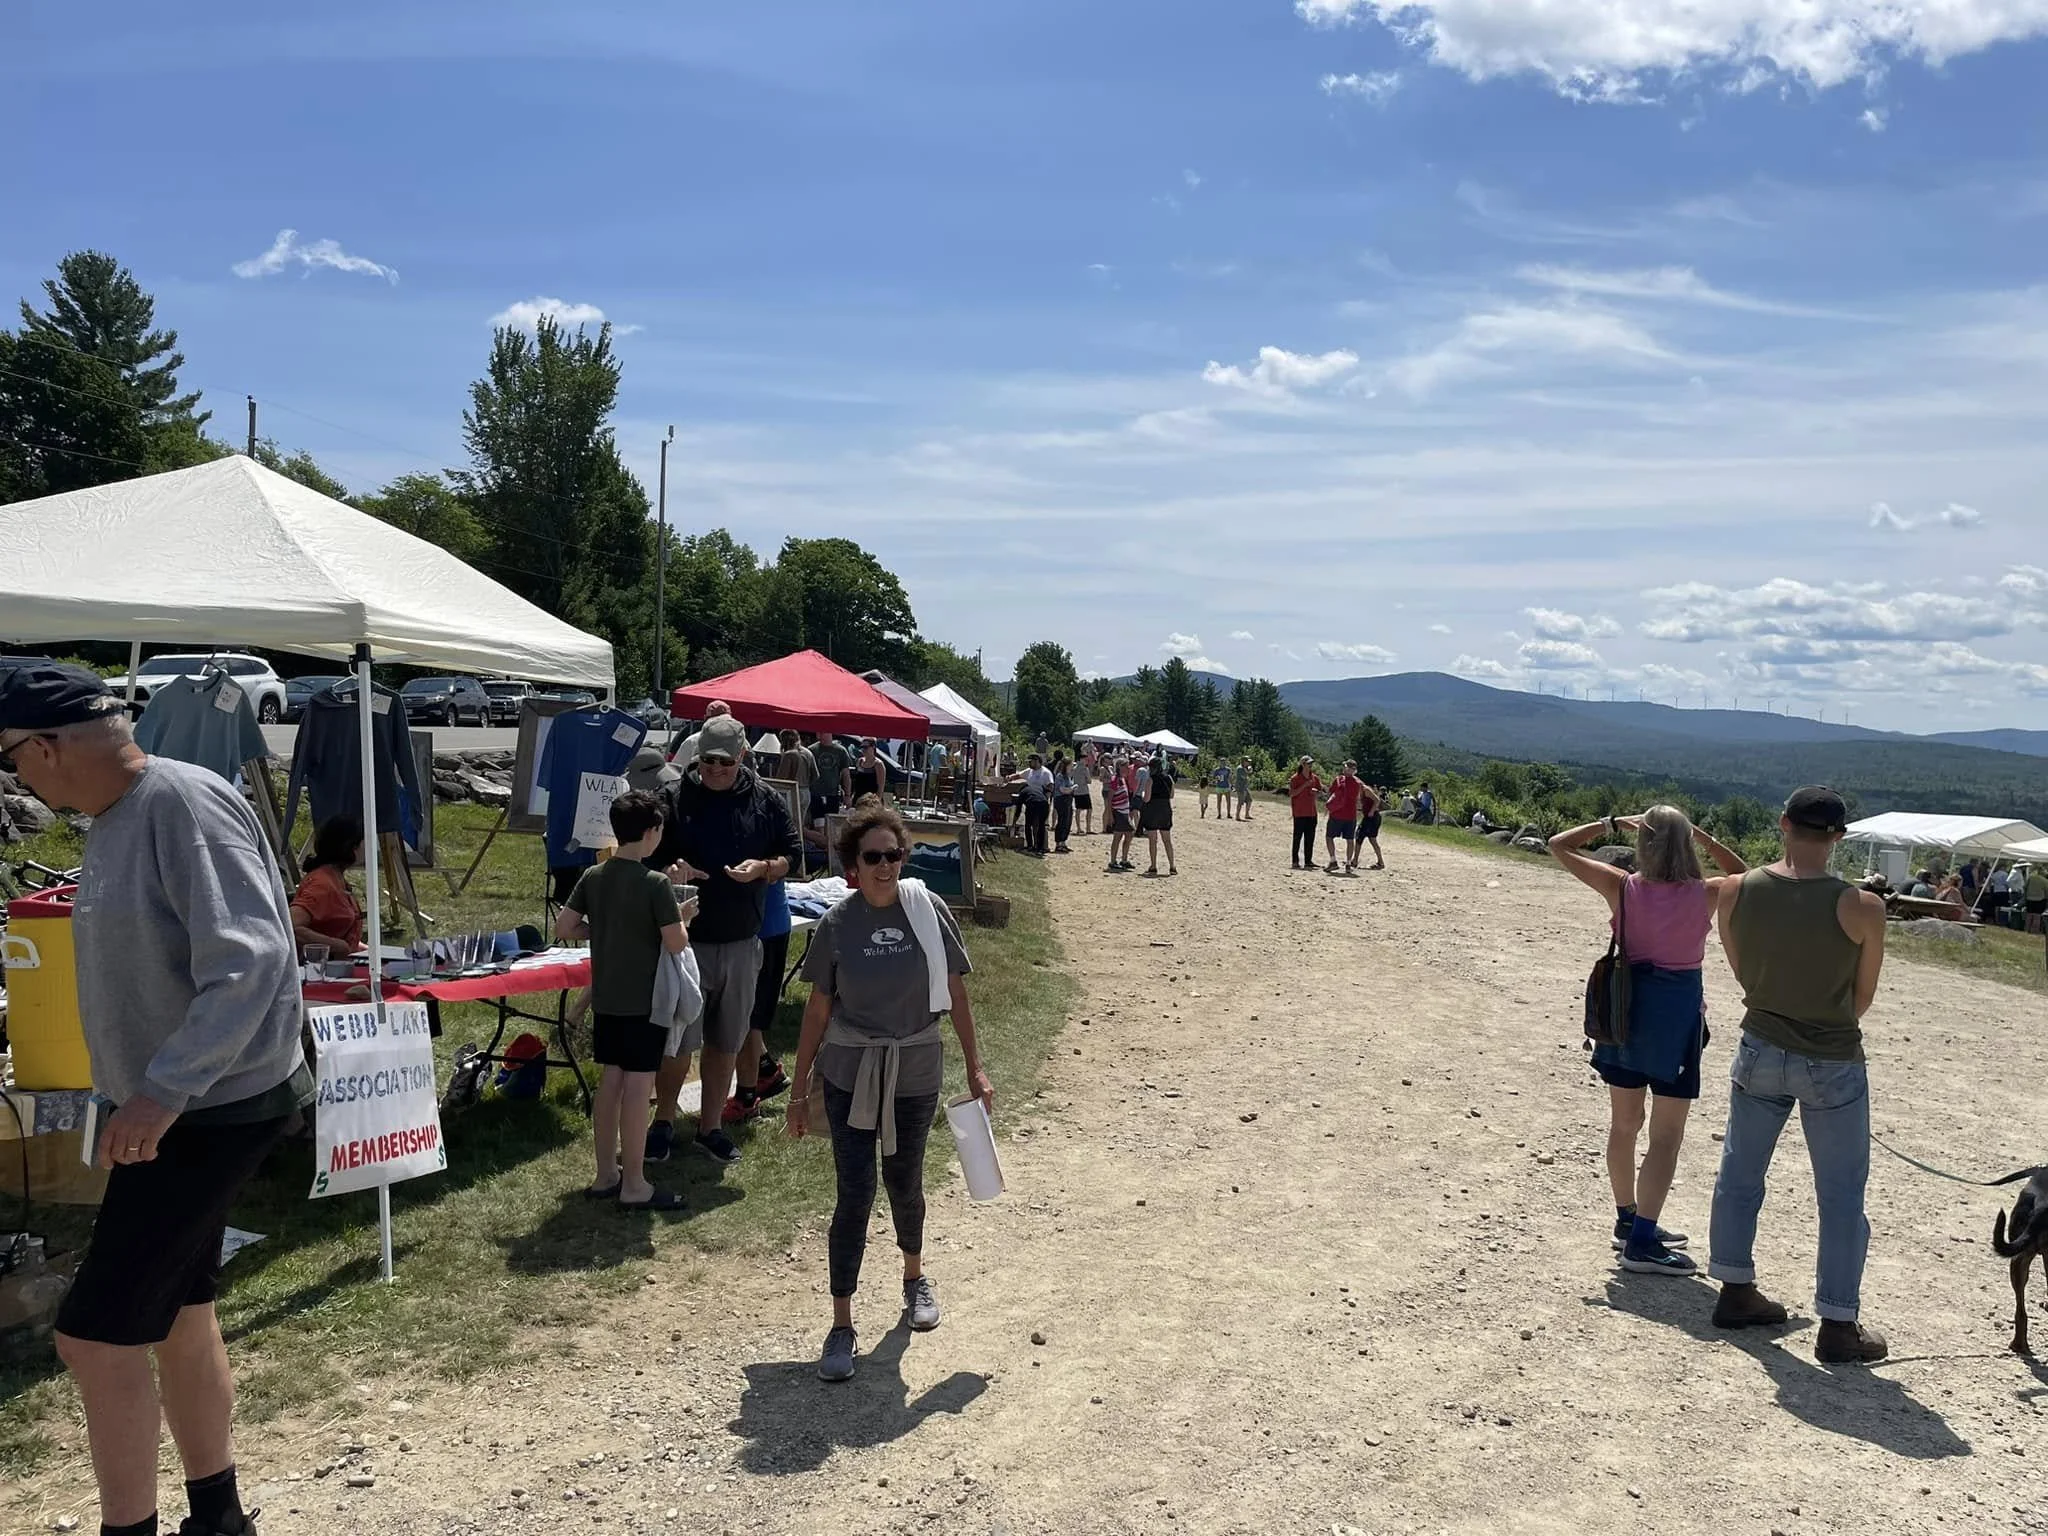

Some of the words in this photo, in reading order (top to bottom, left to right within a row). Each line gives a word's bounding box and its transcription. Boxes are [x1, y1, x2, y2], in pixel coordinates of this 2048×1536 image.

[312, 1011, 378, 1043] WEBB
[389, 1009, 429, 1036] LAKE
[317, 1063, 431, 1106] ASSOCIATION
[330, 1123, 438, 1174] MEMBERSHIP
